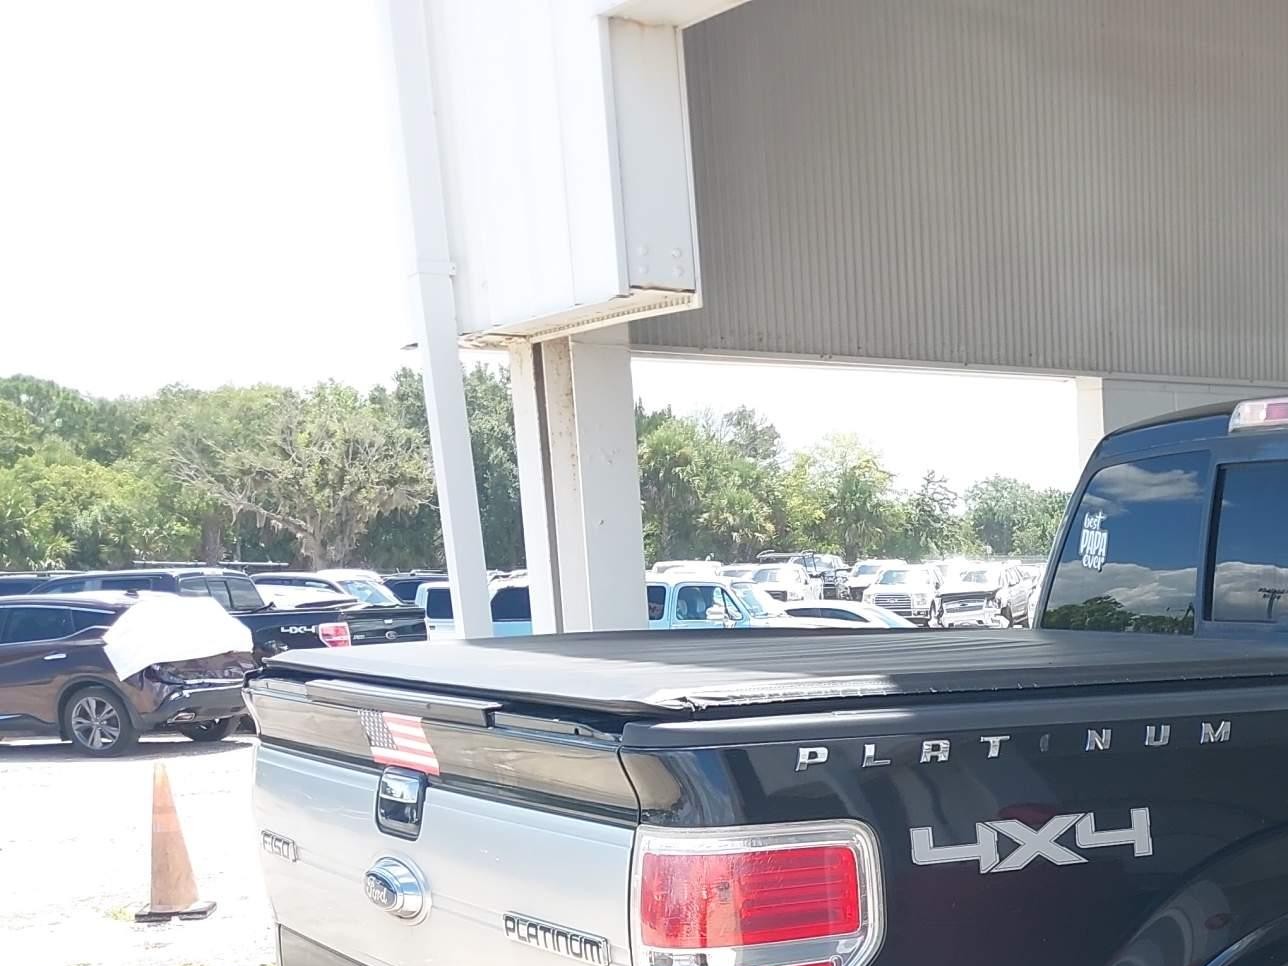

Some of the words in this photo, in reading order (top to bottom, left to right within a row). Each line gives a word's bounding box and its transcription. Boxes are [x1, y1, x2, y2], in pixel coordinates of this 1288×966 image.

[1083, 511, 1107, 530] best
[1080, 529, 1108, 557] PAPA
[1082, 554, 1105, 571] ever
[795, 720, 1231, 771] PLATINUM
[910, 807, 1153, 874] 4X4
[504, 915, 602, 964] PLATINUM
